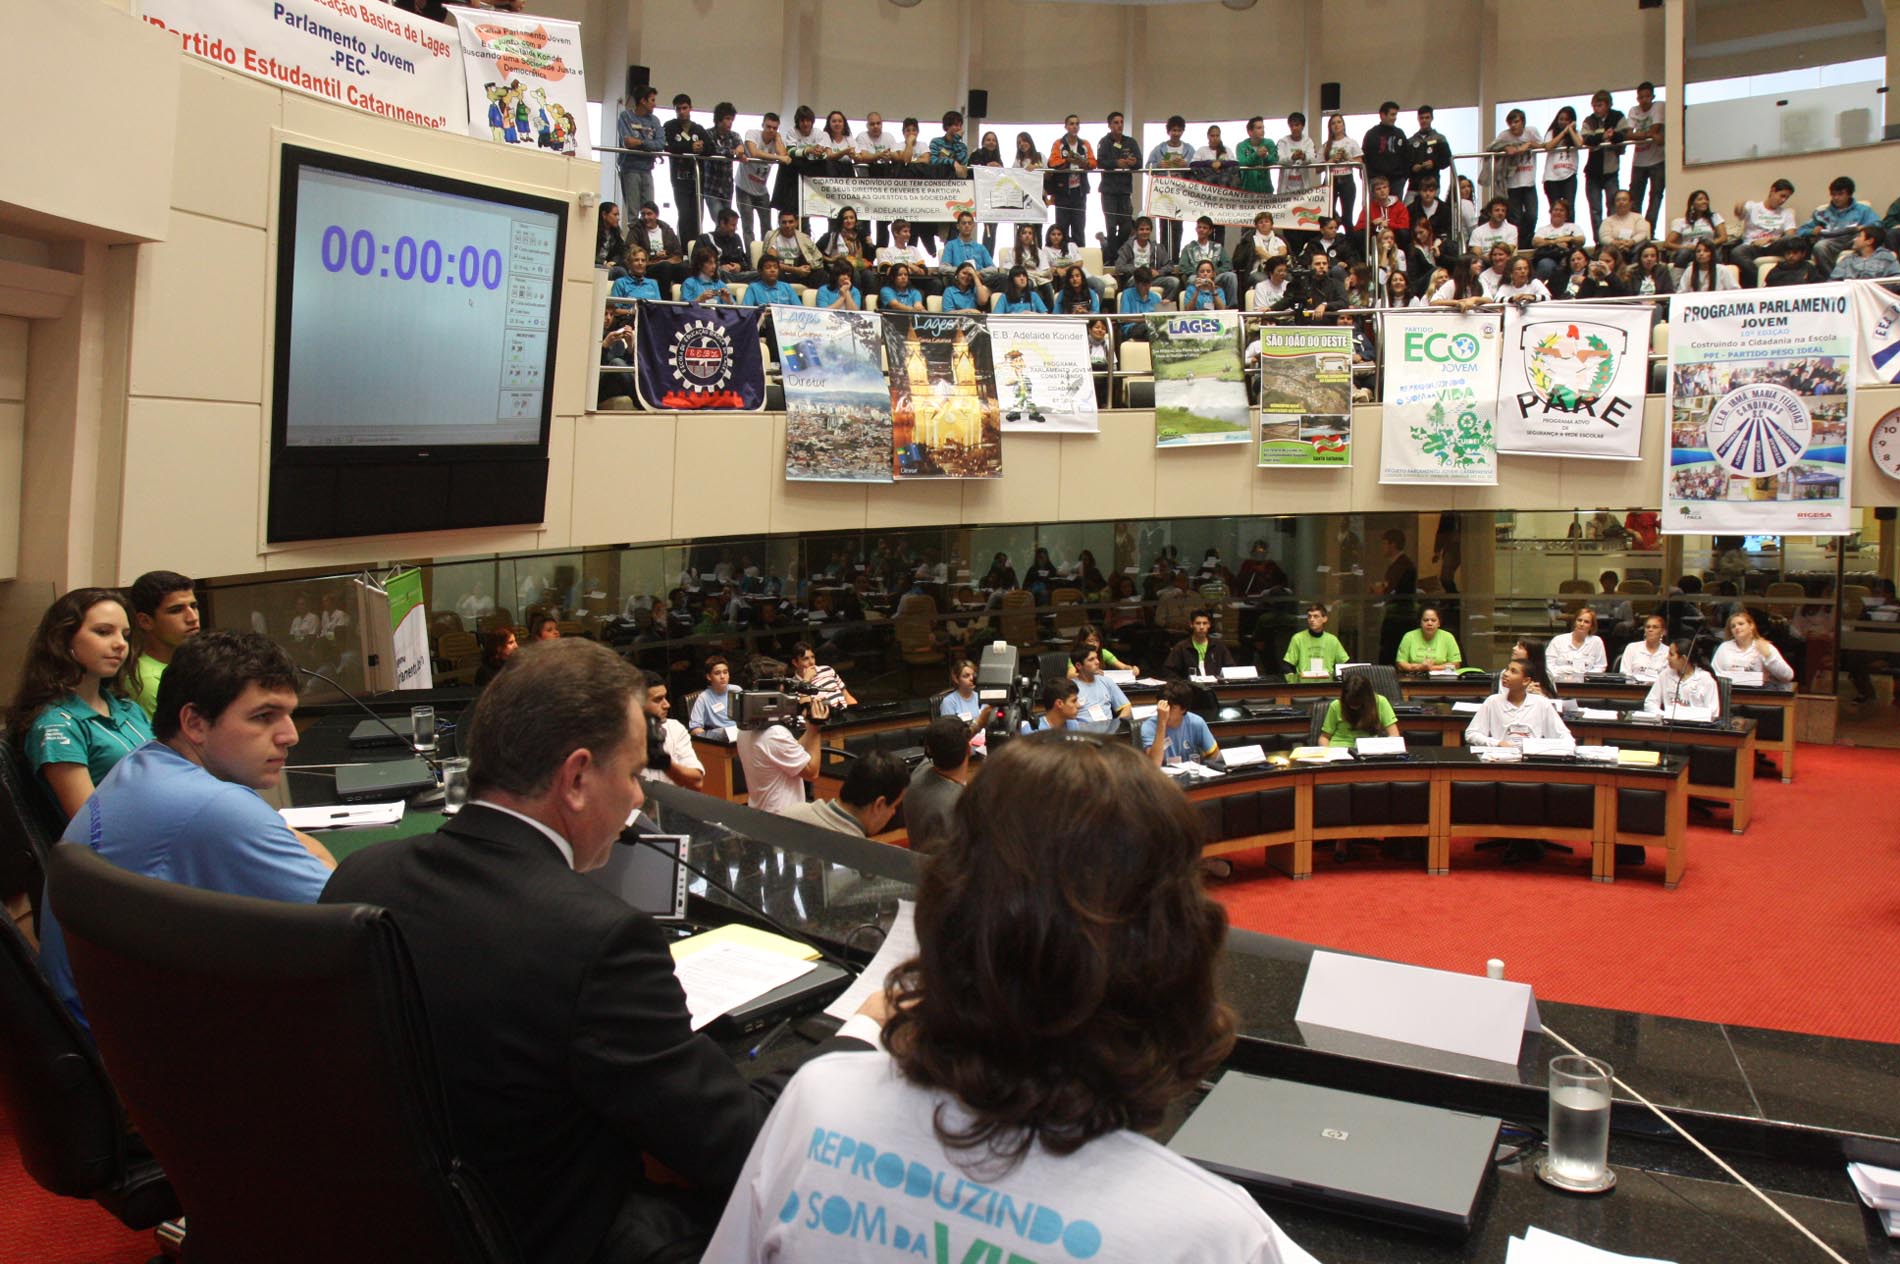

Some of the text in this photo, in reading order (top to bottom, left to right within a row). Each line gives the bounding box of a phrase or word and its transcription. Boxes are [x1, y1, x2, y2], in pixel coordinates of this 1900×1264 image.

[274, 2, 415, 75] Parlamento Jovem
[360, 4, 401, 37] Basica
[404, 23, 418, 43] de
[420, 29, 451, 58] Lages
[548, 34, 572, 45] Jovem
[463, 47, 502, 60] Buscando
[244, 47, 342, 100] Estudantil
[321, 224, 503, 290] 00:00:00
[1683, 296, 1847, 323] PROGRAMA PARLAMENTO
[913, 314, 955, 337] Lages
[1169, 318, 1221, 334] LAGES
[1741, 316, 1788, 329] JOVEM
[1013, 331, 1051, 340] Adelaide
[1053, 331, 1084, 340] Konder
[1266, 333, 1348, 347] SÃO JOÃO DO OESTE
[1691, 341, 1738, 349] Costruindo
[1748, 336, 1792, 346] Cidadania
[1808, 334, 1837, 342] Escola
[1404, 332, 1480, 362] ECO
[1728, 349, 1768, 358] PARTIDO
[1771, 347, 1794, 356] PESO
[1797, 346, 1824, 354] IDEAL
[1441, 363, 1478, 372] JOVEM
[1436, 387, 1475, 402] VIDA
[1516, 391, 1633, 429] PARE
[1884, 426, 1897, 434] 10
[807, 1127, 1102, 1260] REPRODUZINDO
[806, 1189, 888, 1246] SOM
[893, 1225, 929, 1259] DA
